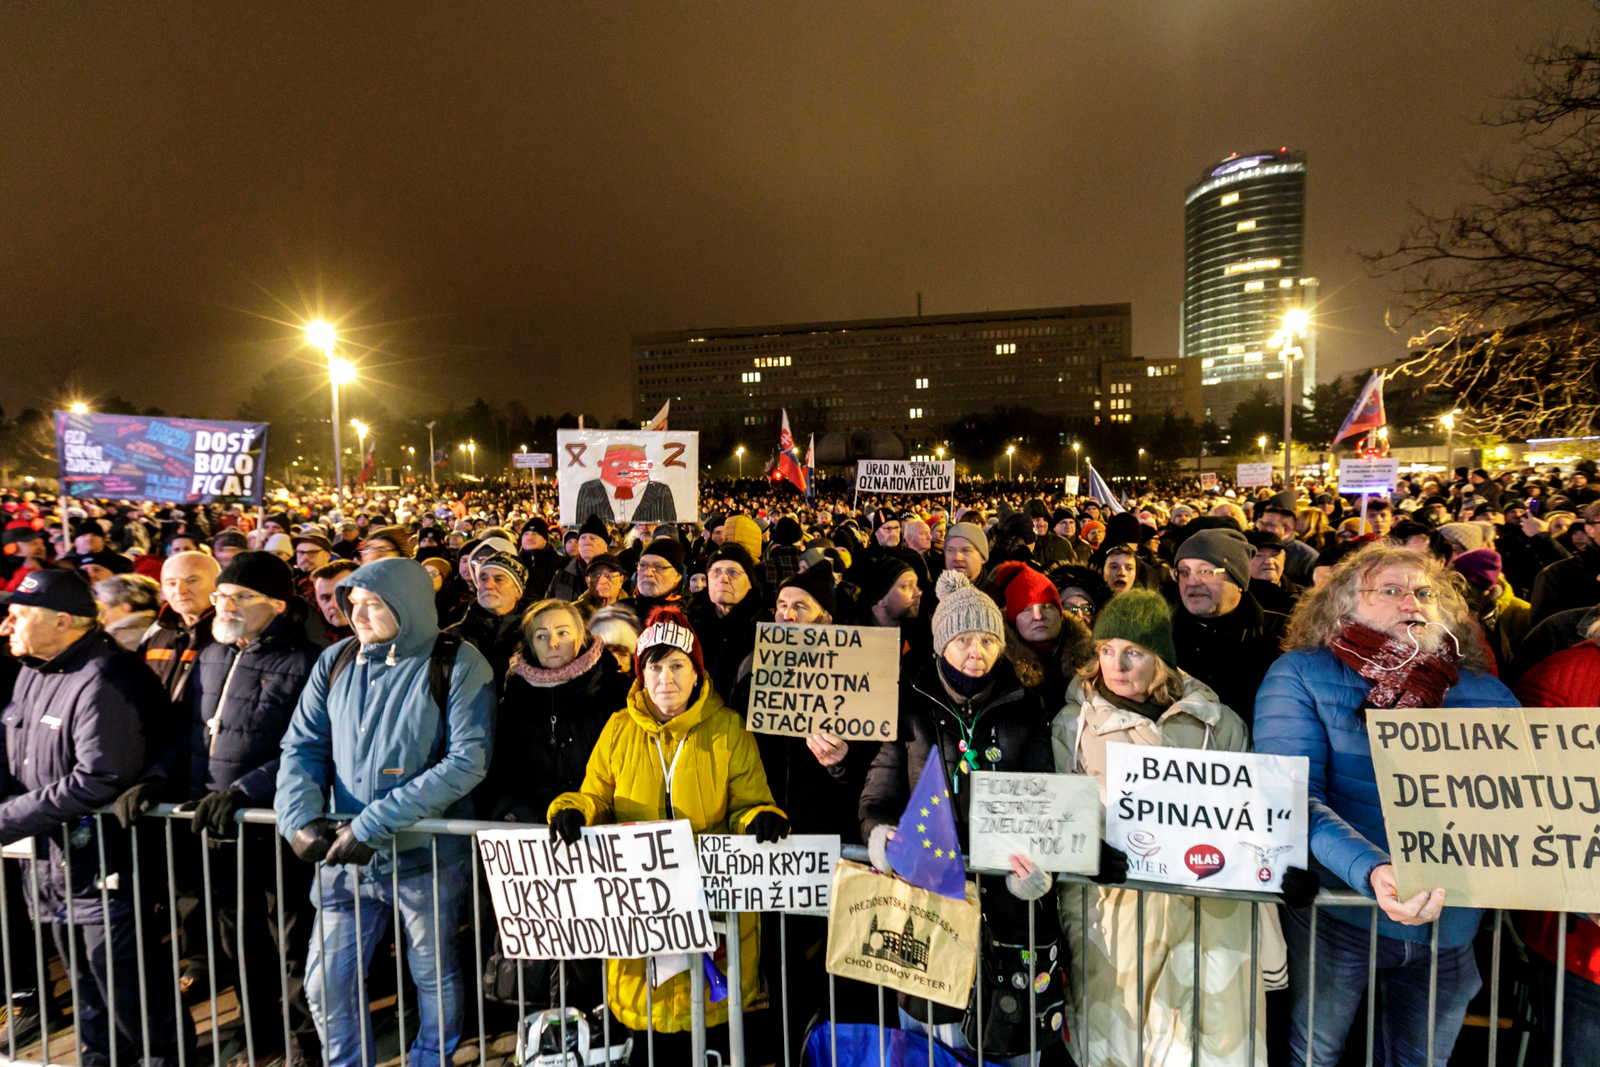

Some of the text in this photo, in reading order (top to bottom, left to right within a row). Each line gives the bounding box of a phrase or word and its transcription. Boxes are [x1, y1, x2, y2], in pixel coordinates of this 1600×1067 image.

[195, 428, 256, 453] DOSŤ
[194, 452, 254, 475] BOLO
[866, 461, 890, 476] ÚRAD
[893, 463, 906, 476] NA
[191, 474, 253, 497] FICA!
[759, 625, 799, 646] KDE
[803, 628, 830, 647] SA
[759, 648, 839, 669] VYBAVIŤ
[755, 668, 870, 692] DOŽIVOTNÁ
[751, 711, 813, 734] STAČI
[1375, 721, 1519, 752] PODLIAK
[1393, 773, 1600, 814] DEMONTUJ
[1118, 790, 1255, 832] ŠPINAVÁ
[480, 829, 679, 876] POLITIKANIE JE
[700, 836, 732, 853] KDE
[1029, 836, 1065, 856] MOC
[1397, 821, 1520, 868] PRÁVNY
[701, 848, 830, 876] VLÁDA KRYJE
[1127, 858, 1168, 875] MER
[1189, 853, 1220, 865] HLAS
[701, 876, 733, 888] TAM
[502, 877, 671, 919] ÚKRYT PRED
[704, 880, 828, 910] MAFIA ŽIJE
[845, 956, 873, 969] CHOĎ
[875, 963, 911, 980] DOMOV
[914, 974, 946, 992] PETER
